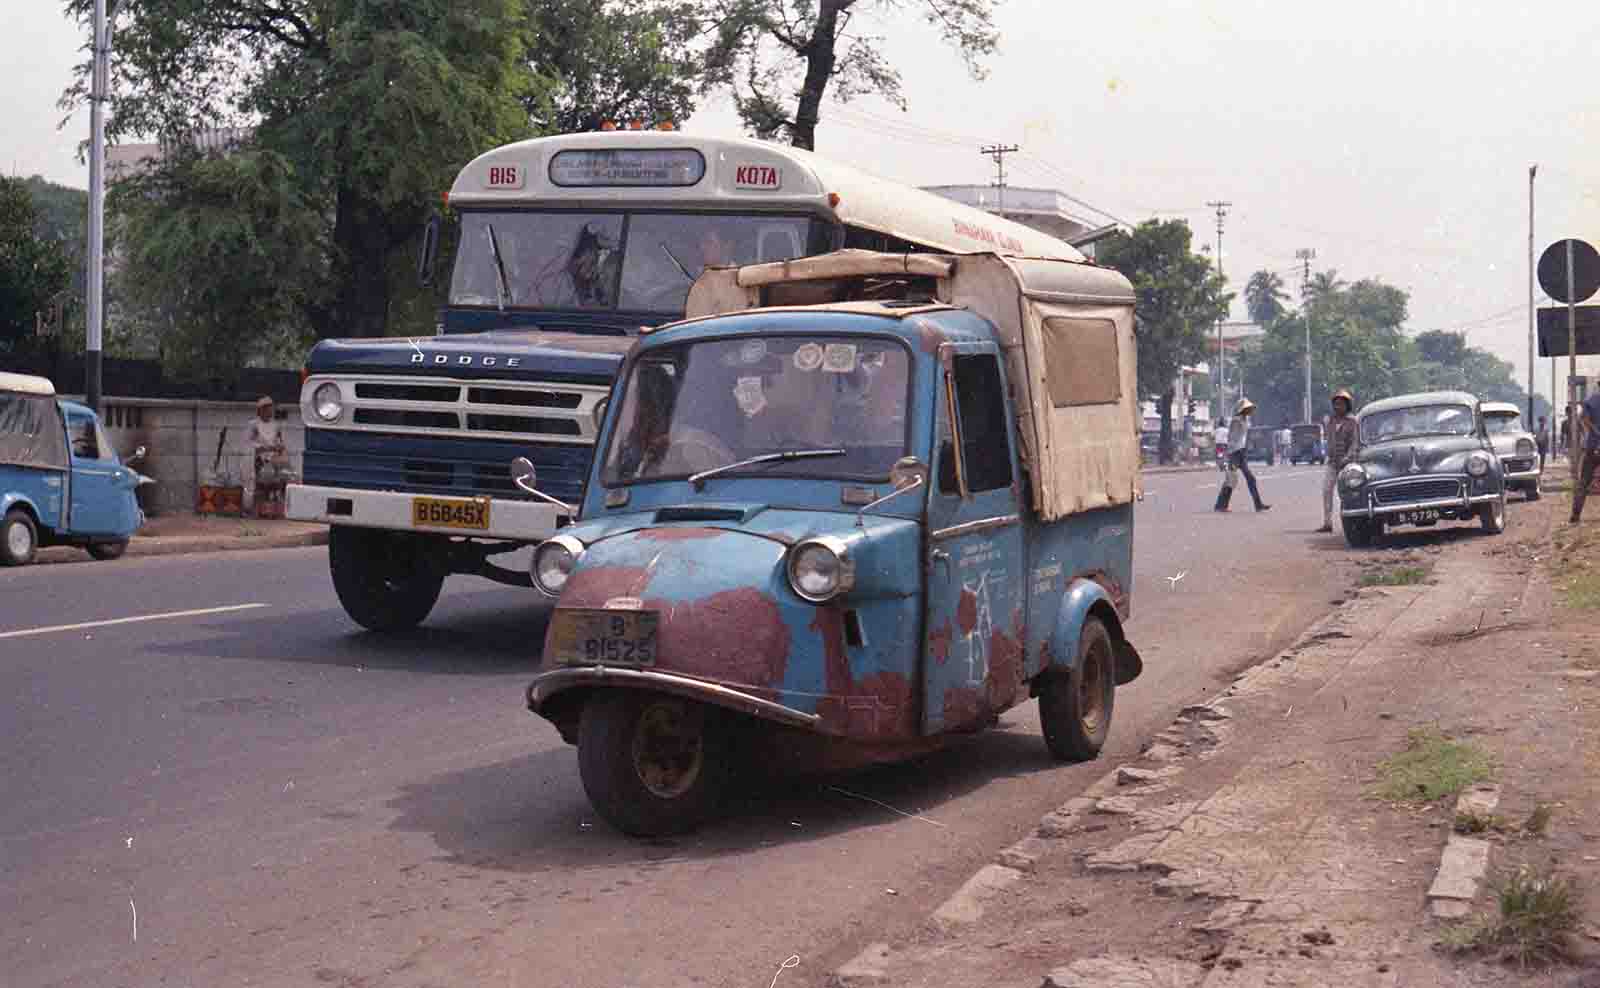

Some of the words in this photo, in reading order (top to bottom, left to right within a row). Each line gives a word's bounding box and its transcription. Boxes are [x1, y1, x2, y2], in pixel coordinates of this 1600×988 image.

[490, 167, 516, 185] BIS
[736, 167, 777, 185] KOTA
[411, 353, 520, 367] DODGE
